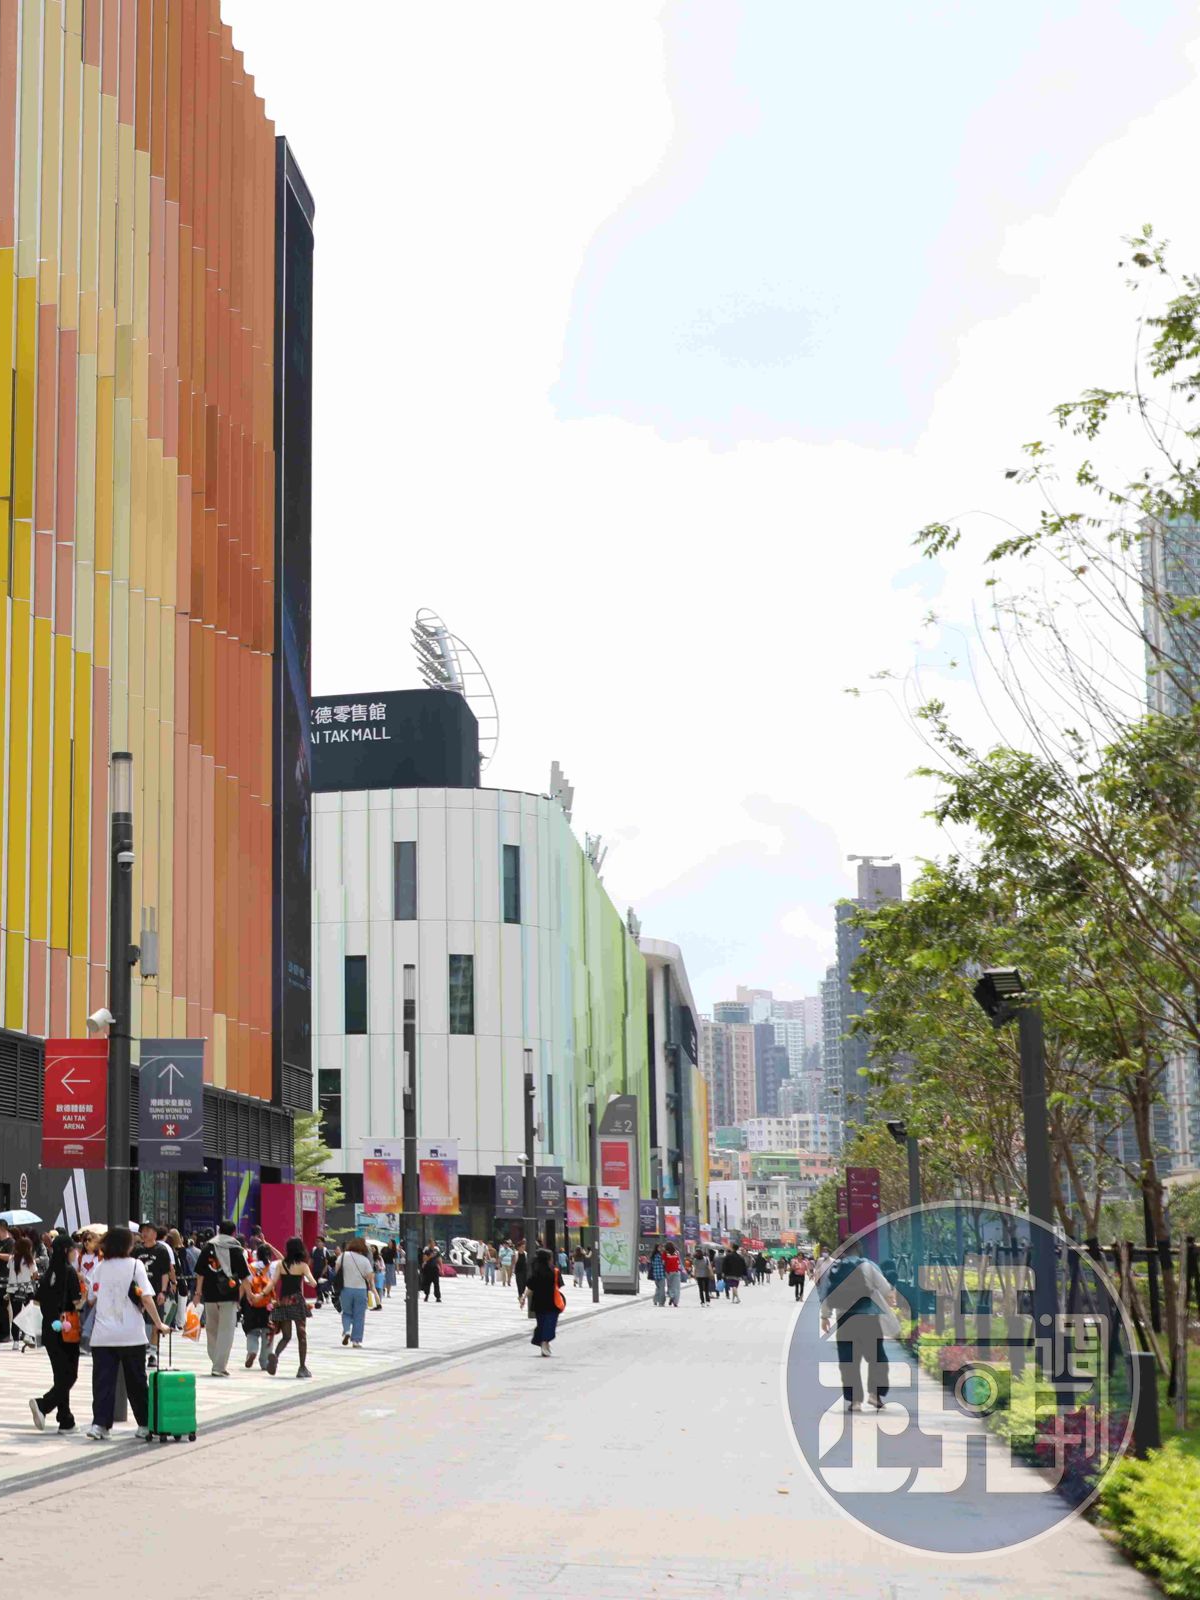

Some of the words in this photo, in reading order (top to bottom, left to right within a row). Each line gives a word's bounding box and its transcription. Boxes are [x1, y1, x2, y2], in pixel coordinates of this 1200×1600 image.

[323, 729, 350, 743] TAK
[351, 726, 391, 741] MALL
[624, 1120, 632, 1133] 2
